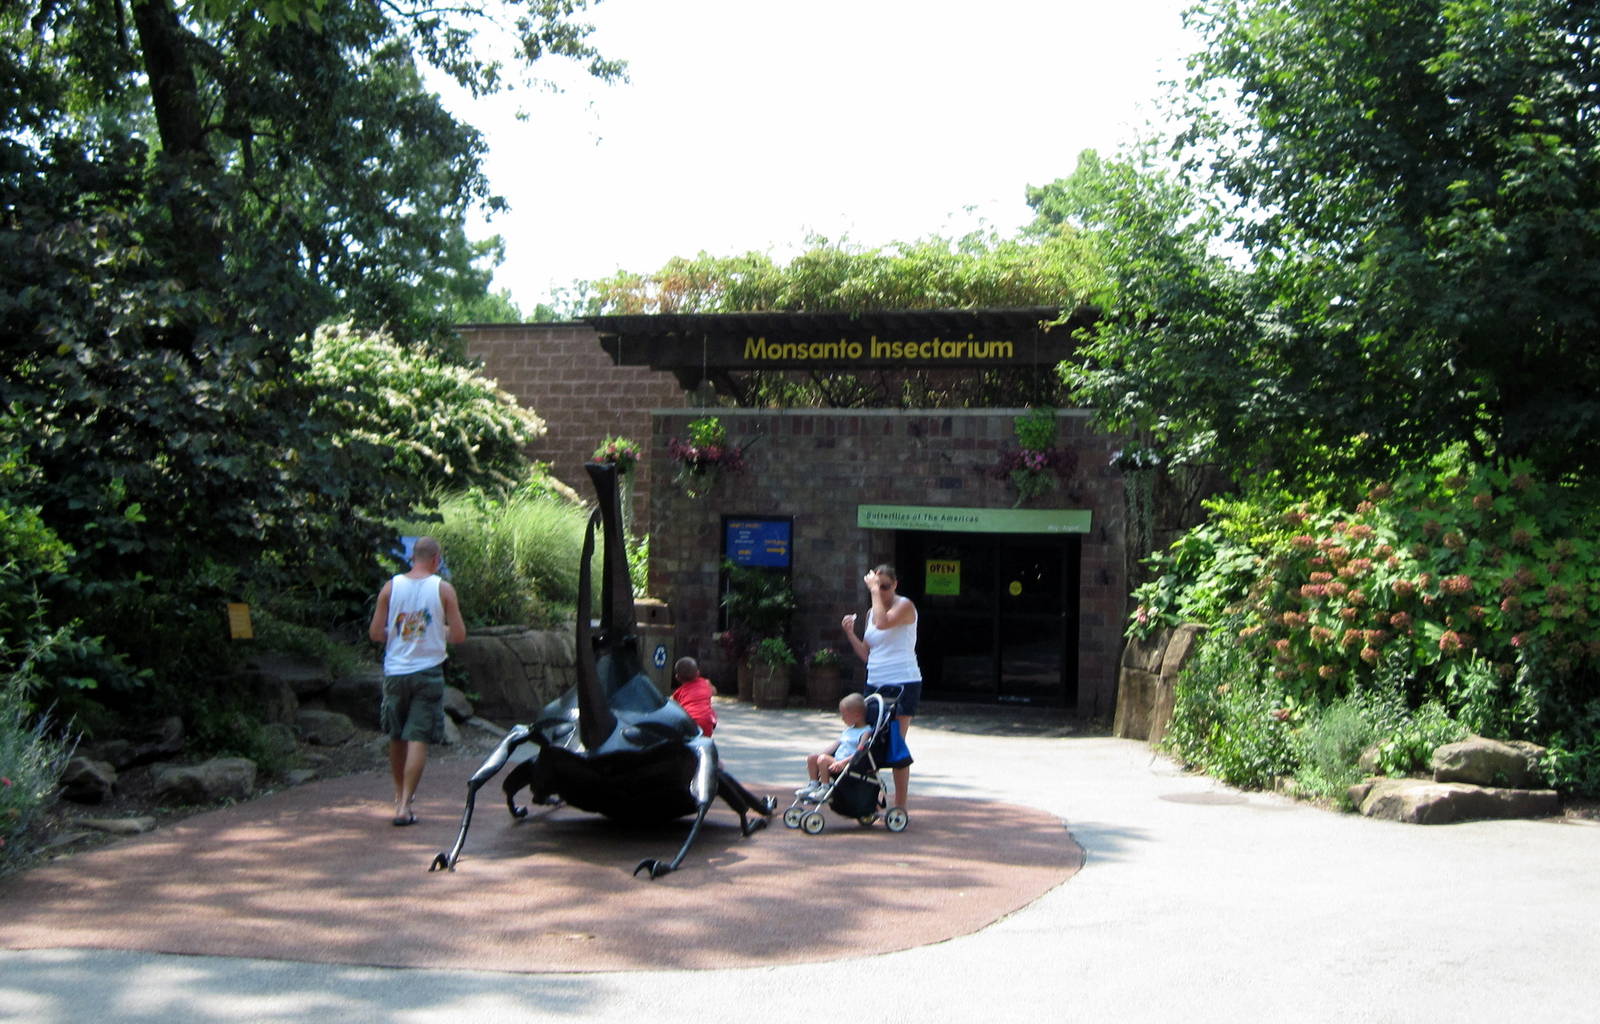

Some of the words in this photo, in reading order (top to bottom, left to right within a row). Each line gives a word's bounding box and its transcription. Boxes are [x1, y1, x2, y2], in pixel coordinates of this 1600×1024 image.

[743, 337, 863, 360] Monsanto
[870, 334, 1014, 359] Insectarium
[929, 563, 956, 574] OPEN
